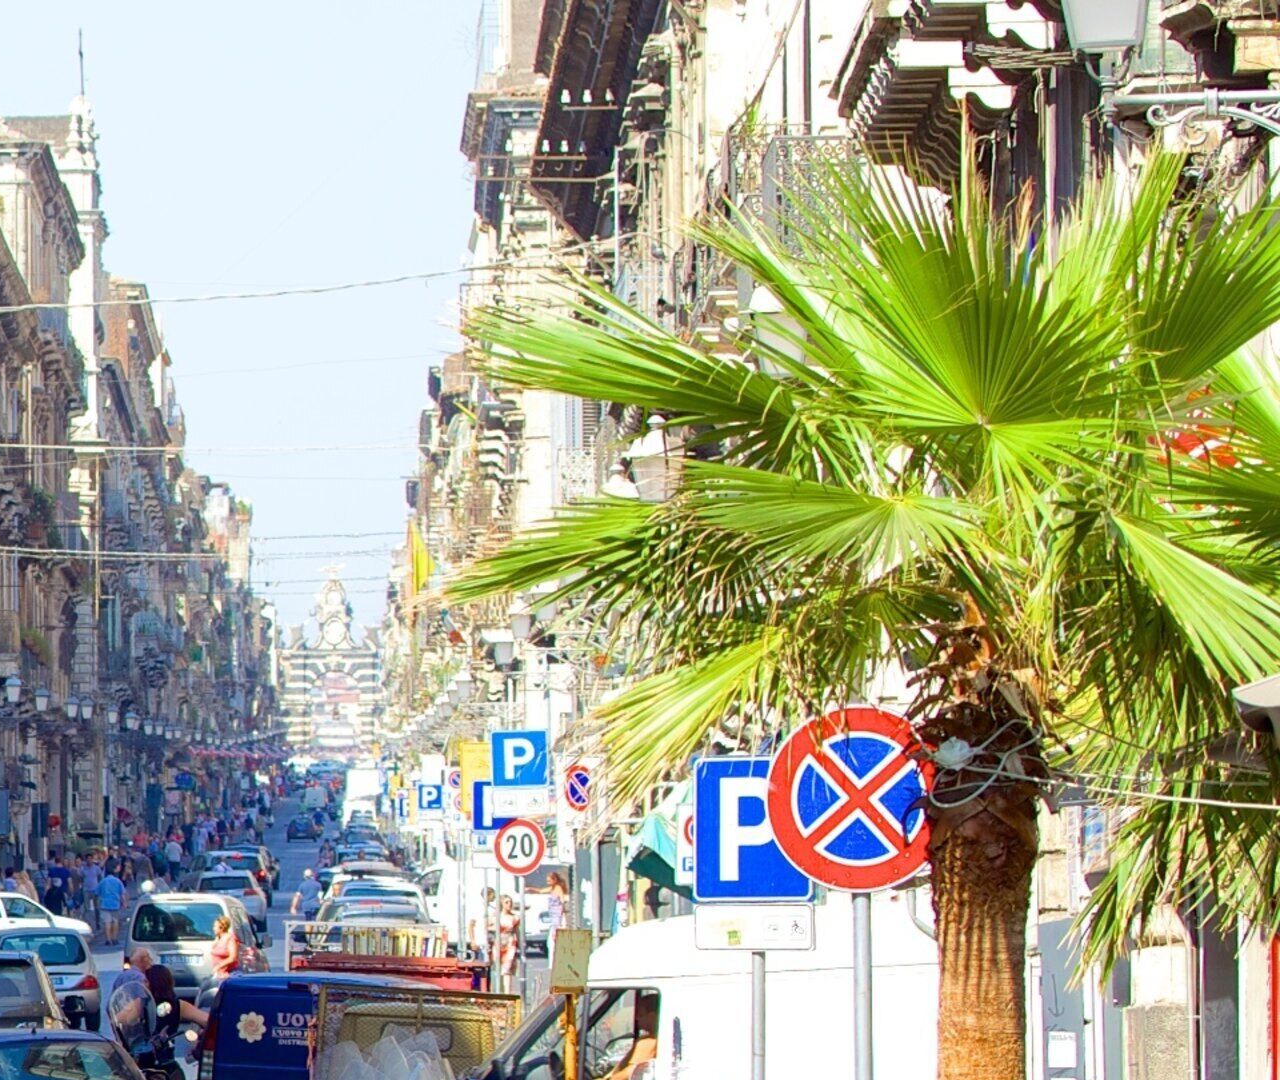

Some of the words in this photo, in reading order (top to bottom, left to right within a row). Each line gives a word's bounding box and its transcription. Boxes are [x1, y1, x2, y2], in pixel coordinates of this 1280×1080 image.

[504, 738, 535, 780] P
[422, 787, 438, 808] P
[719, 777, 773, 882] P
[506, 833, 534, 860] 20
[277, 1012, 318, 1027] UOV
